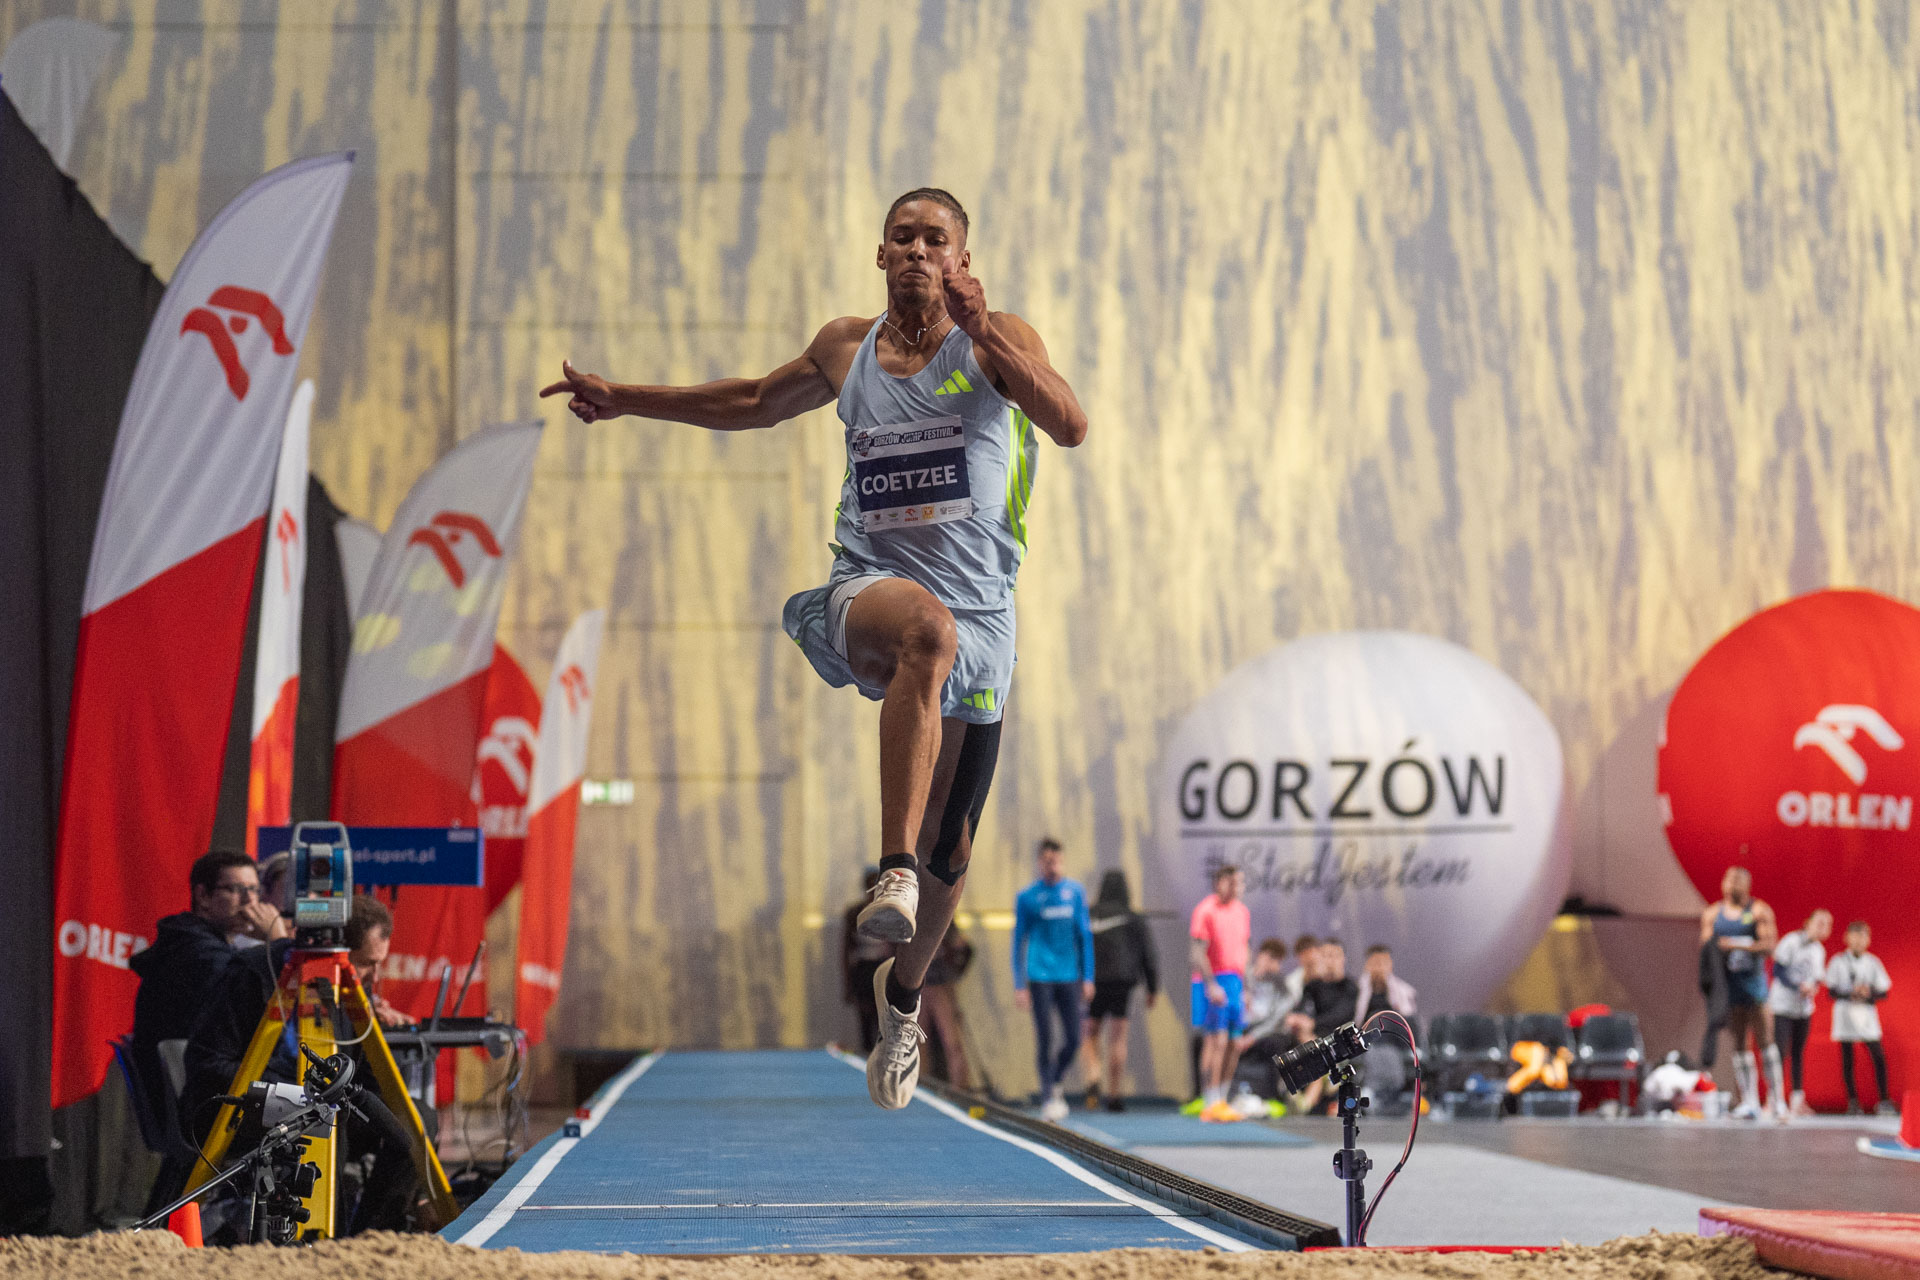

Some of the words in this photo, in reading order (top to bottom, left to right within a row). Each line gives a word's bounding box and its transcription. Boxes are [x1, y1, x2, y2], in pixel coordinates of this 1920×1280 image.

[873, 431, 900, 447] GORZÓW
[901, 431, 922, 444] JUMP
[923, 426, 955, 440] FESTIVAL
[861, 464, 958, 495] COETZEE
[1179, 738, 1505, 820] GORZÓW
[1776, 790, 1913, 831] ORLEN
